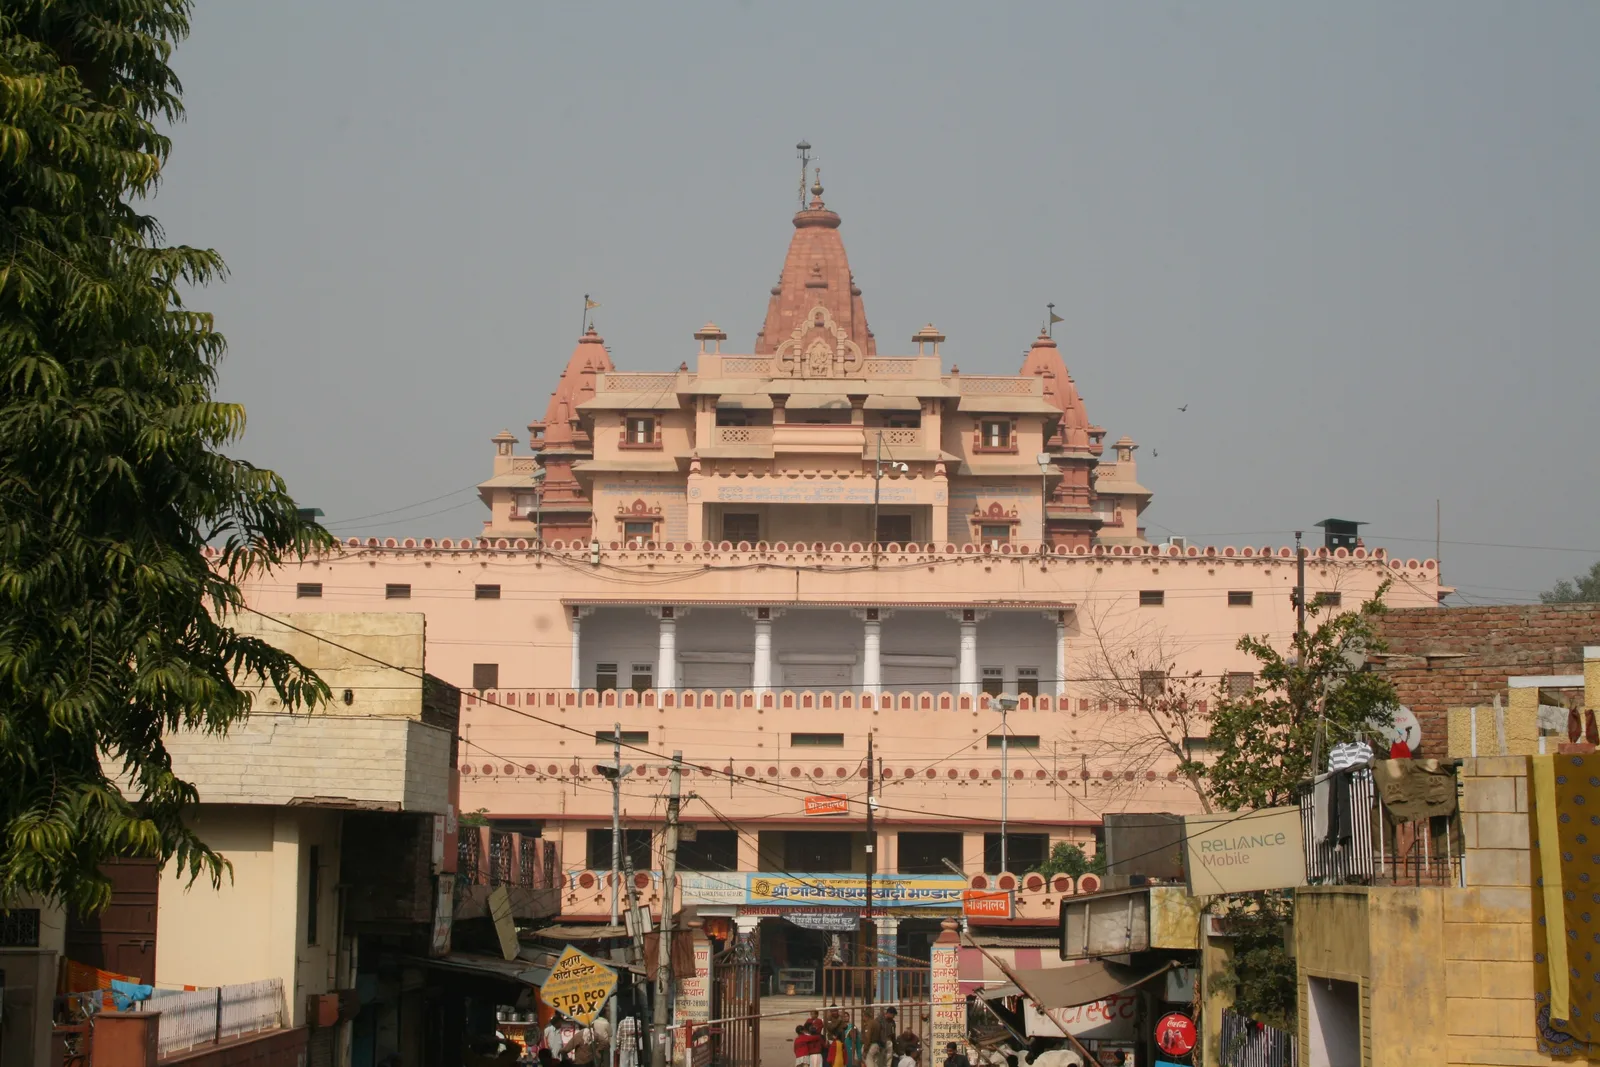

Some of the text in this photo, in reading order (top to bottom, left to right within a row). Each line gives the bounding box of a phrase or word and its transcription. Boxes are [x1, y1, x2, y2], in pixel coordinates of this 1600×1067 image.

[1203, 852, 1250, 867] Mobile
[772, 882, 789, 897] श्री
[968, 894, 1006, 911] भोजनालय
[584, 989, 606, 1001] PCO
[569, 1001, 597, 1016] FAX
